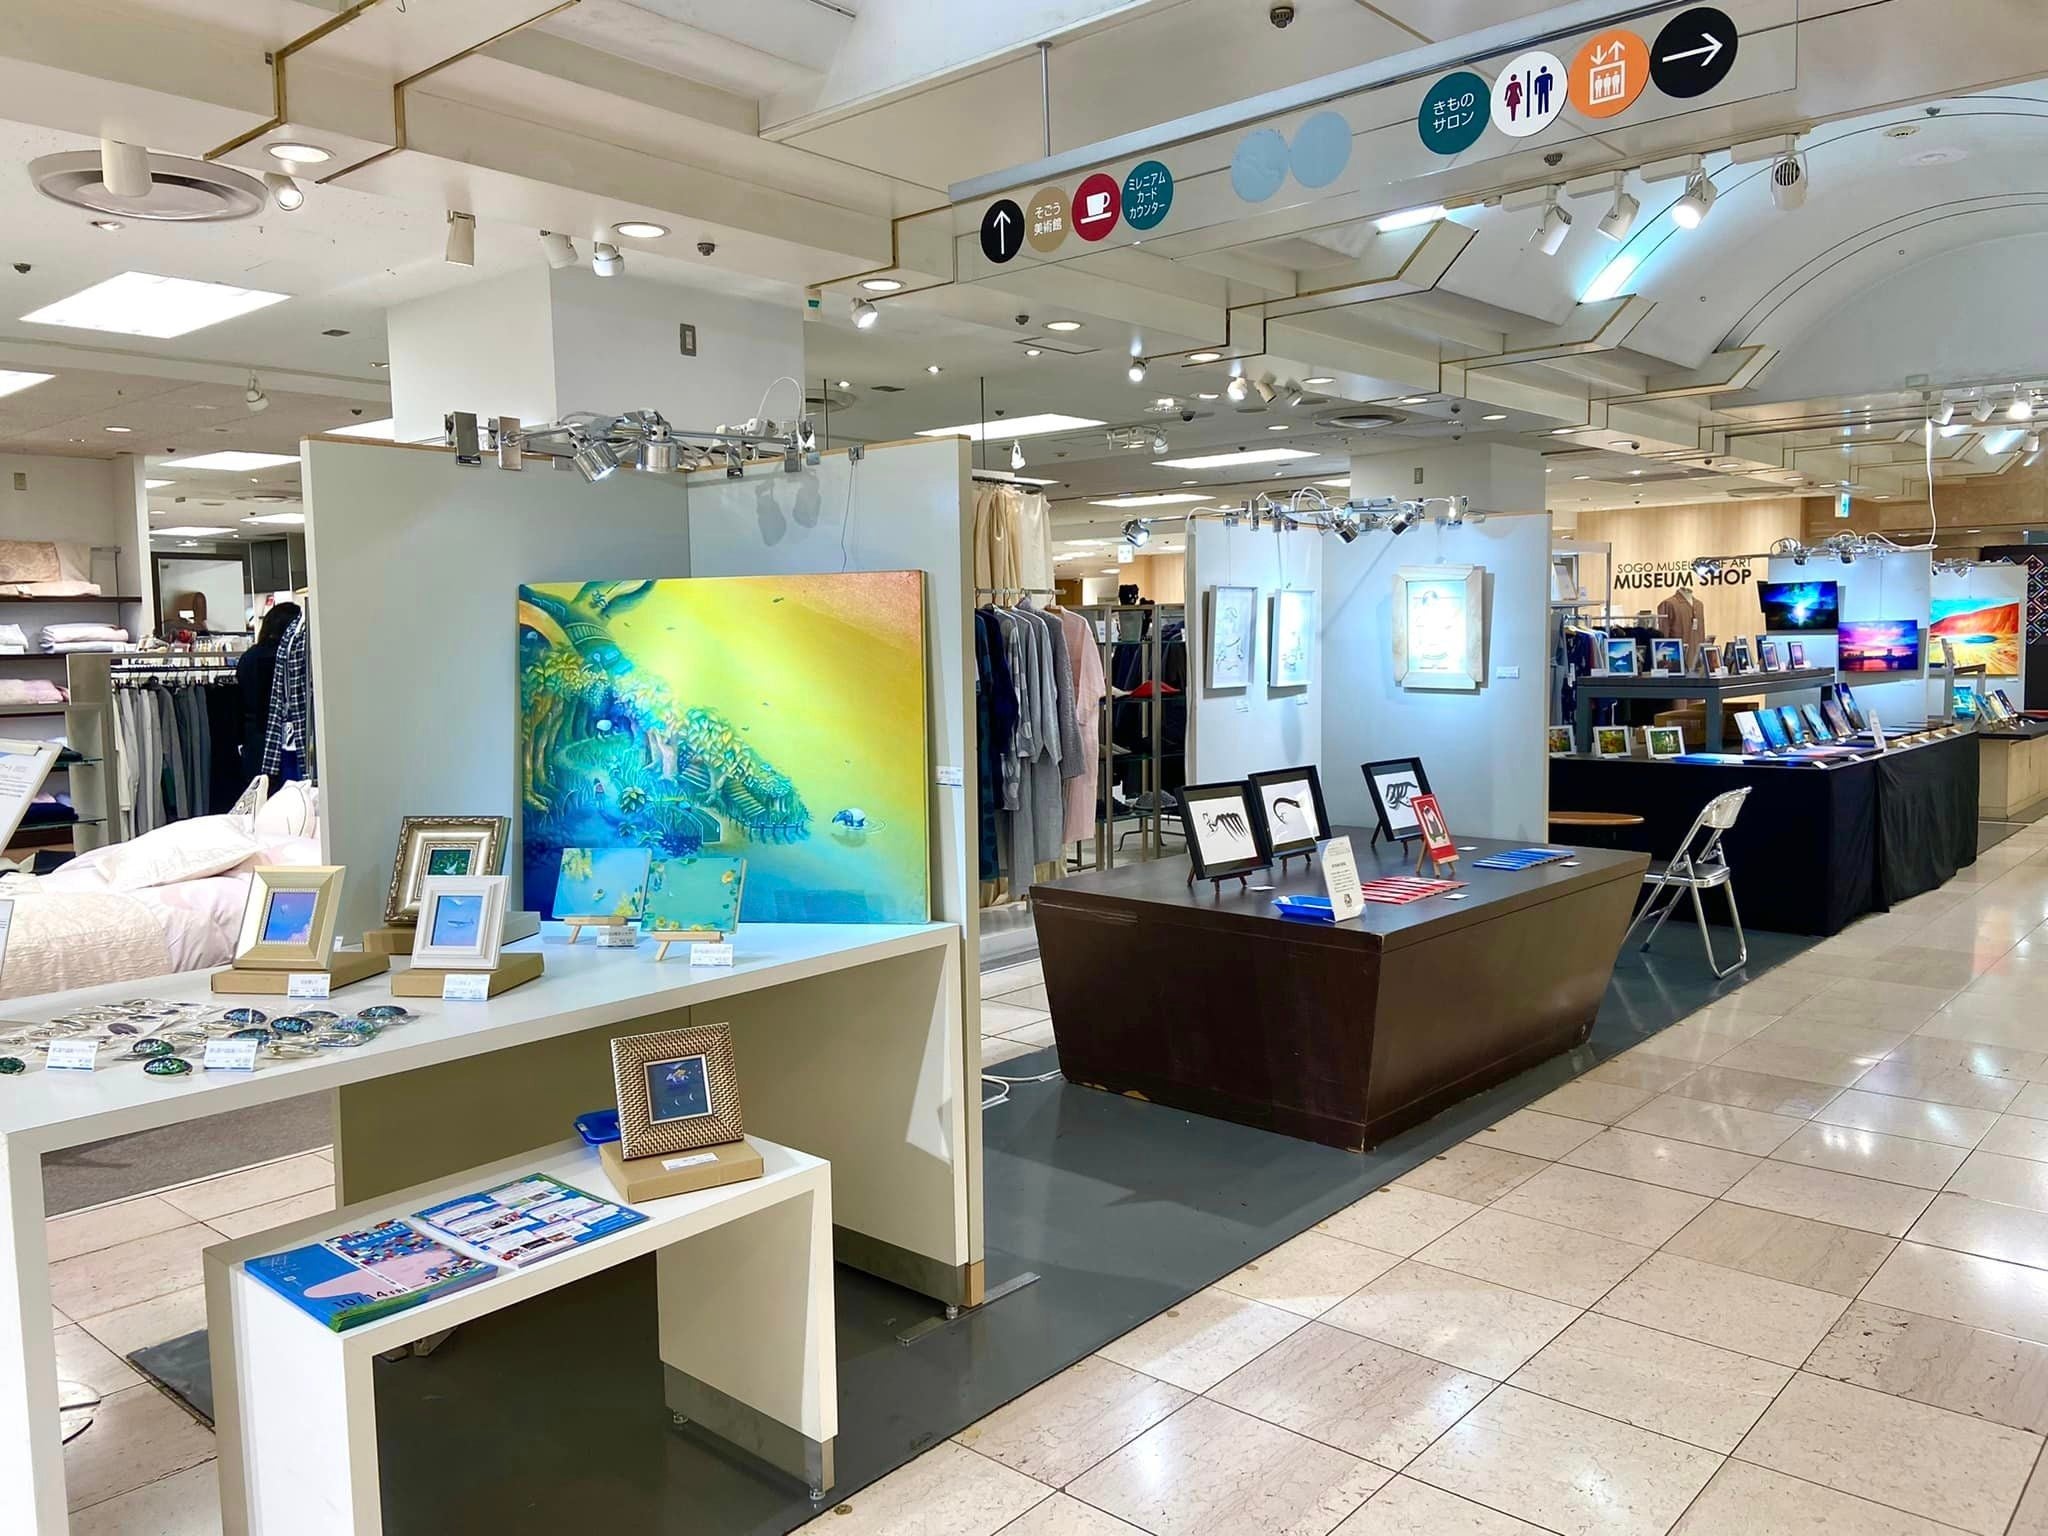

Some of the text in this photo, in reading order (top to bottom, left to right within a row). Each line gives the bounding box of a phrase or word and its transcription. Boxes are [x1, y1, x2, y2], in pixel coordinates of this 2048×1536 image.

[1433, 92, 1475, 116] きもの
[1432, 111, 1475, 134] サロン
[1128, 171, 1166, 191] ミレニアム
[1136, 187, 1157, 203] カード
[1034, 202, 1061, 219] そごう
[1129, 202, 1166, 220] カウンター
[1033, 217, 1062, 236] 美術館
[1617, 562, 1654, 574] SOGO
[1730, 557, 1752, 569] ART
[1613, 569, 1752, 590] MUSEUM SHOP
